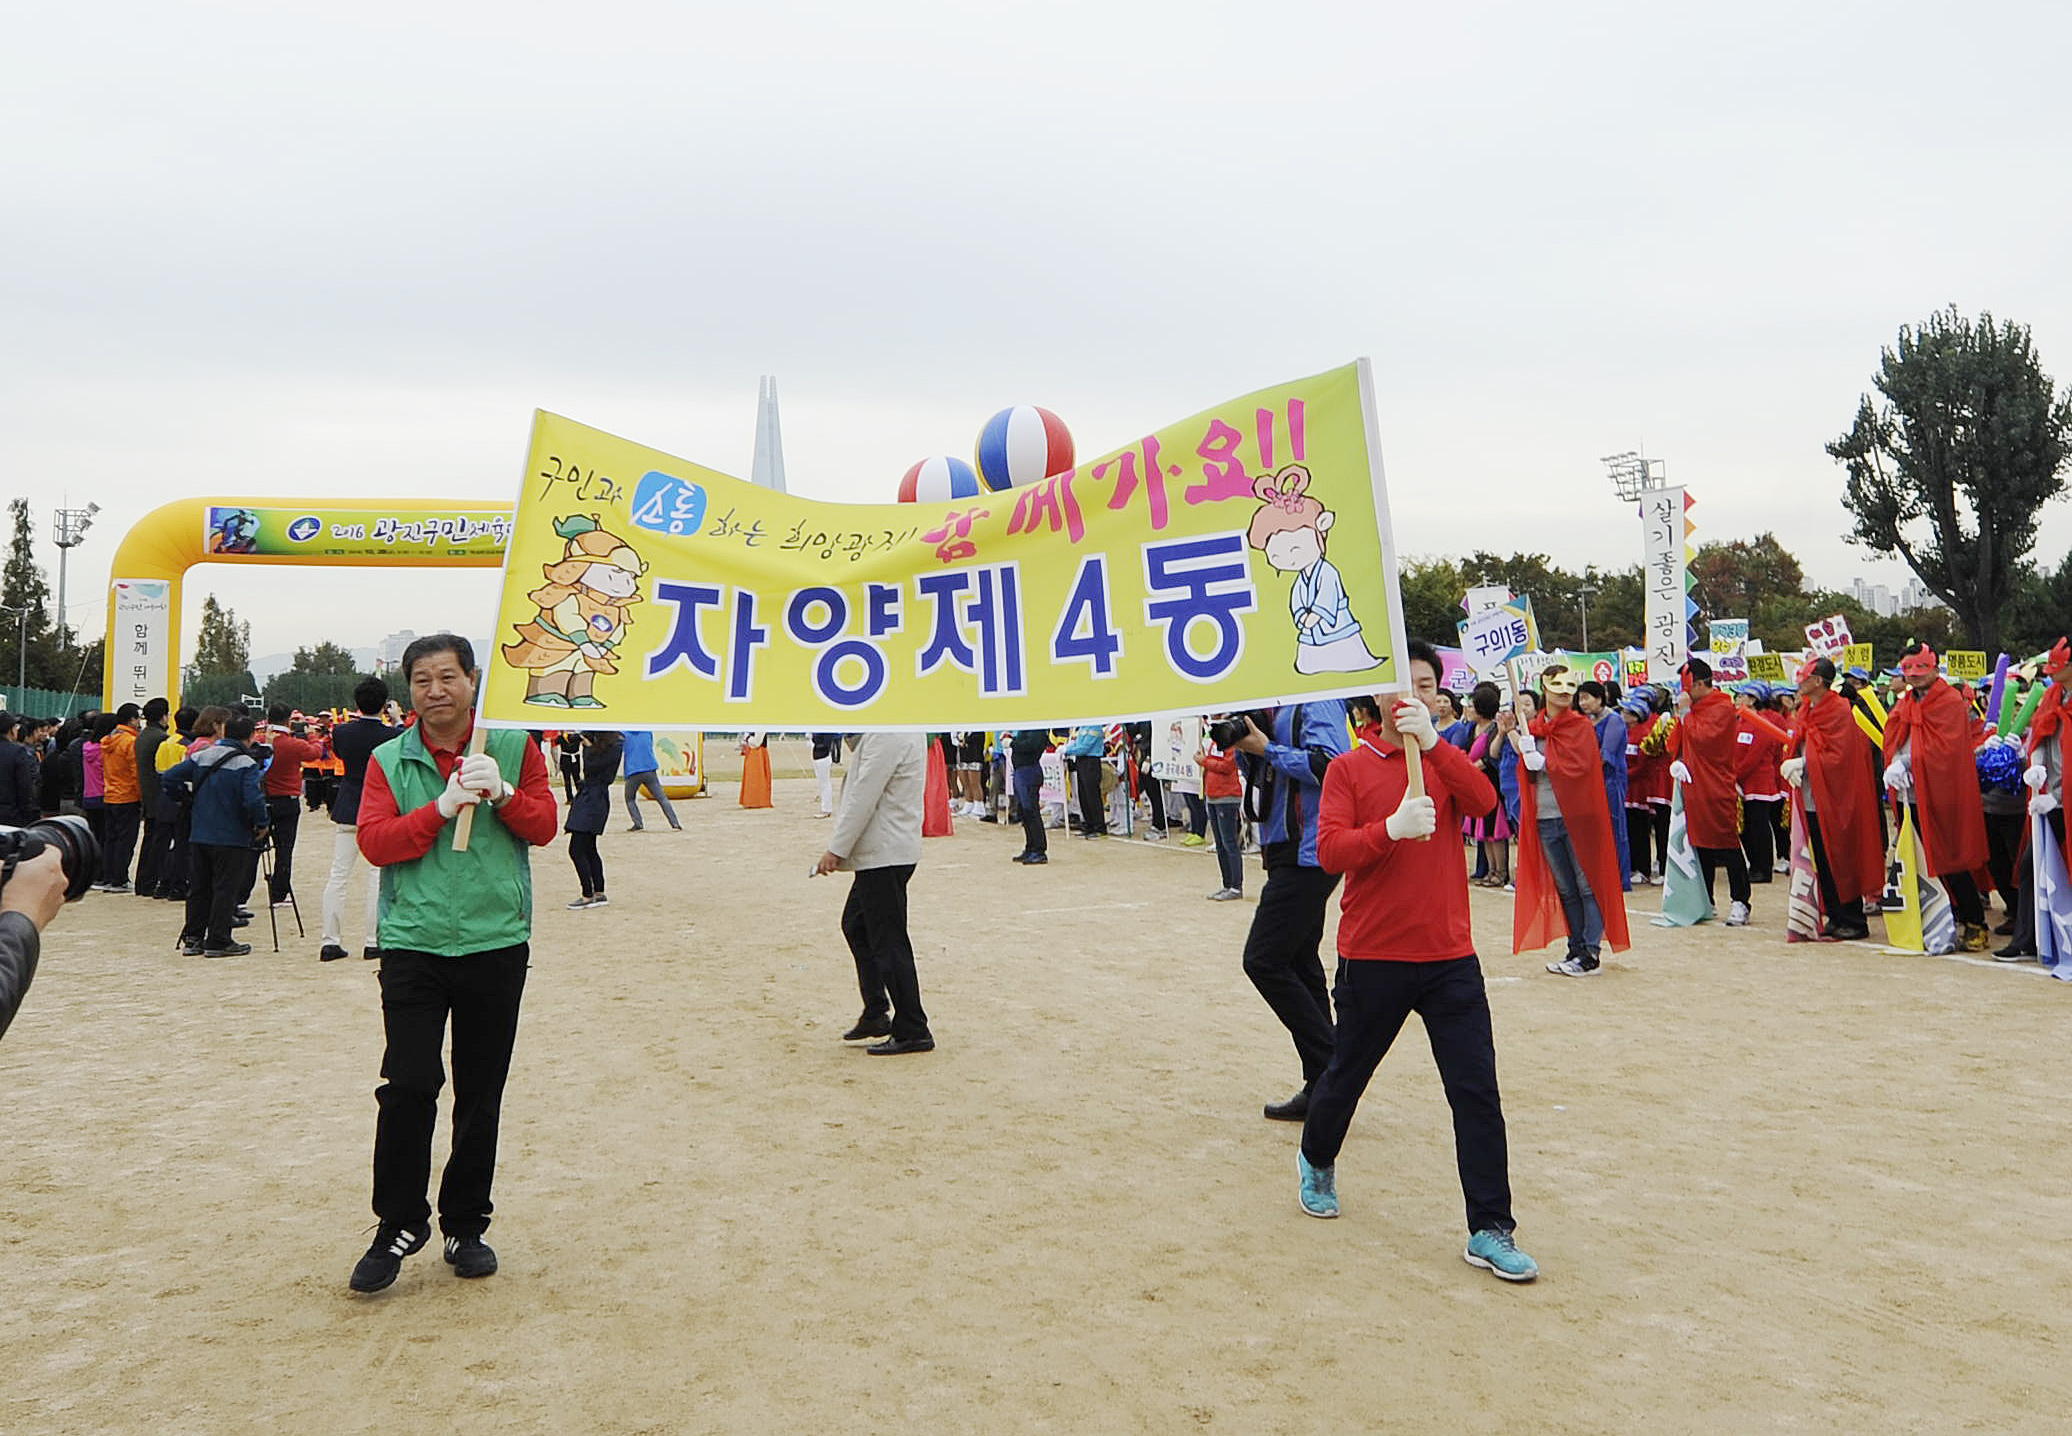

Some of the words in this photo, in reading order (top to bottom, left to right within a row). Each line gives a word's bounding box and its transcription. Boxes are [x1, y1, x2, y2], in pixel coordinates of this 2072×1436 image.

[539, 456, 624, 504] 구민과
[628, 479, 698, 537] 소통
[708, 508, 768, 547] 하는
[332, 524, 365, 538] 2016
[373, 517, 512, 545] 광진구민체육
[132, 623, 148, 655] 함께
[645, 532, 1255, 708] 자양제4동
[1473, 618, 1528, 657] 구의1동
[1653, 611, 1679, 667] 광진
[132, 665, 148, 698] 뛰는
